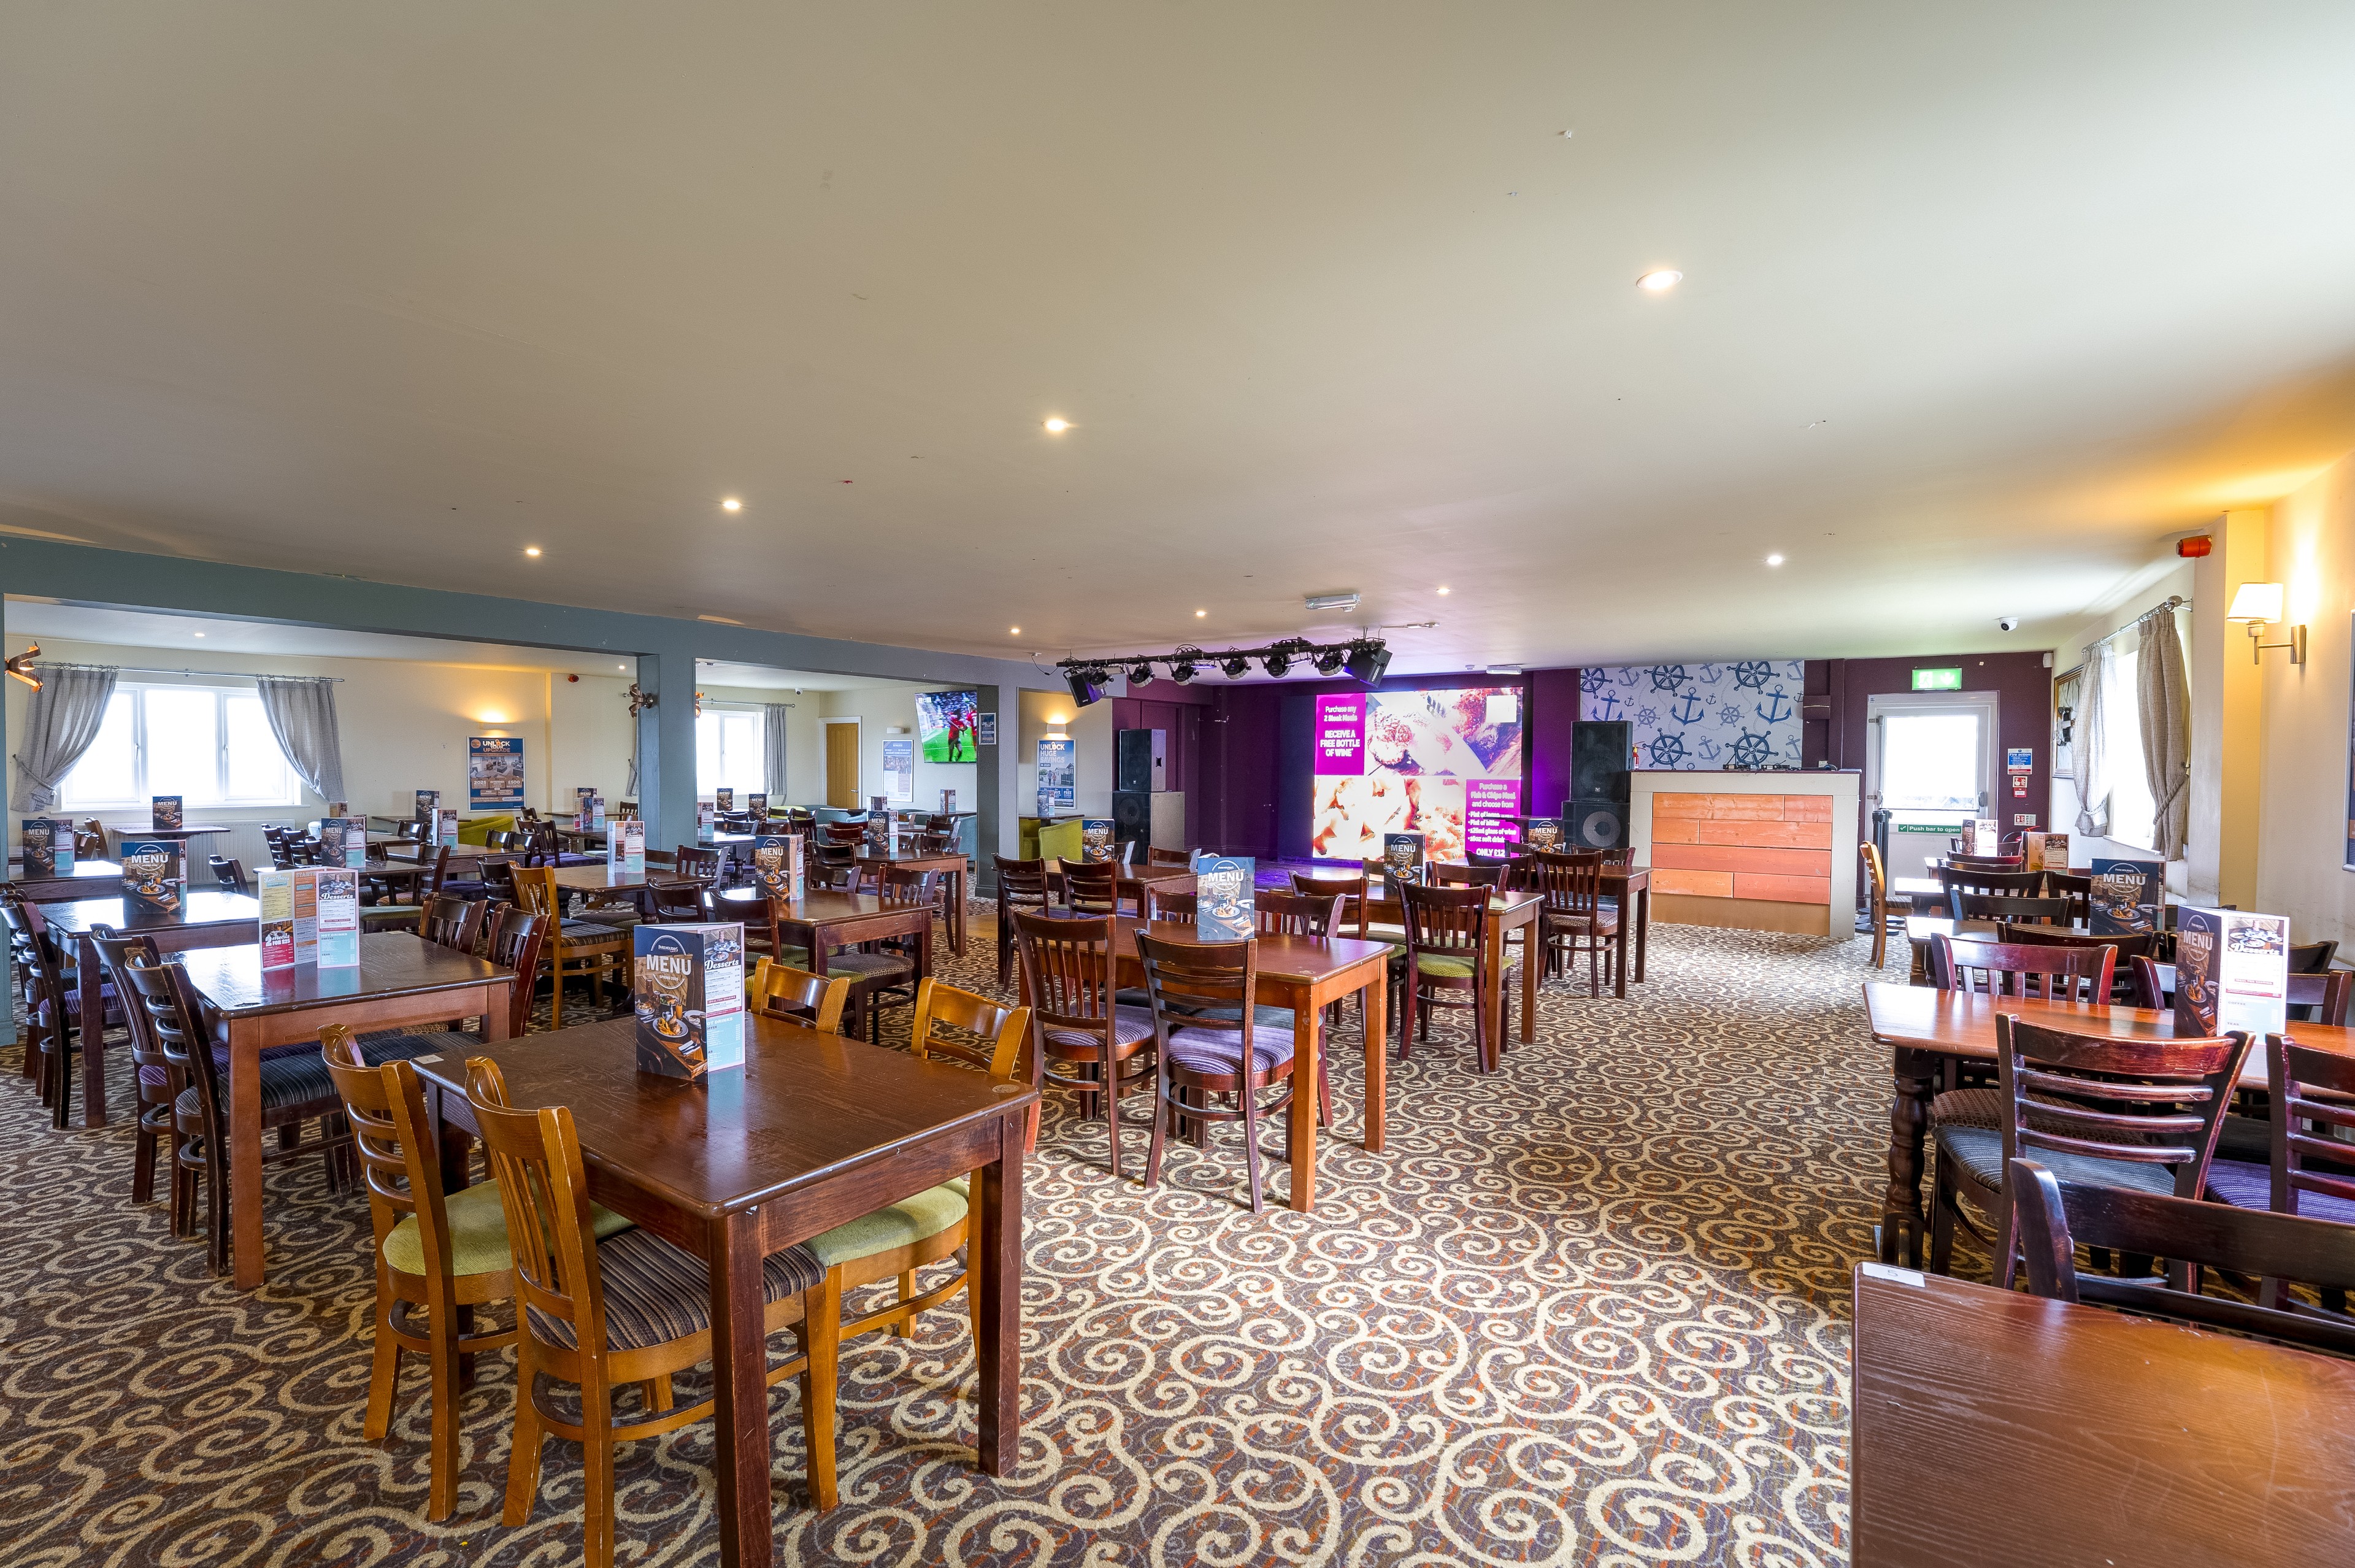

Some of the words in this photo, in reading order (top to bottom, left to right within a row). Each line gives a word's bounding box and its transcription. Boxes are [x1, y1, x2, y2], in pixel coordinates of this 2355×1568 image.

[1351, 729, 1356, 738] A
[1326, 748, 1334, 757] OF
[761, 847, 783, 856] MENU
[1391, 844, 1416, 853] MENU
[1476, 848, 1493, 856] ONLY
[131, 855, 169, 863] MENU
[1208, 872, 1244, 882] MENU
[2103, 874, 2146, 885] MENU
[265, 934, 272, 947] 2
[2183, 929, 2213, 950] MENU
[2231, 943, 2280, 955] Desserts
[647, 954, 691, 975] MENU
[705, 959, 739, 970] Desserts
